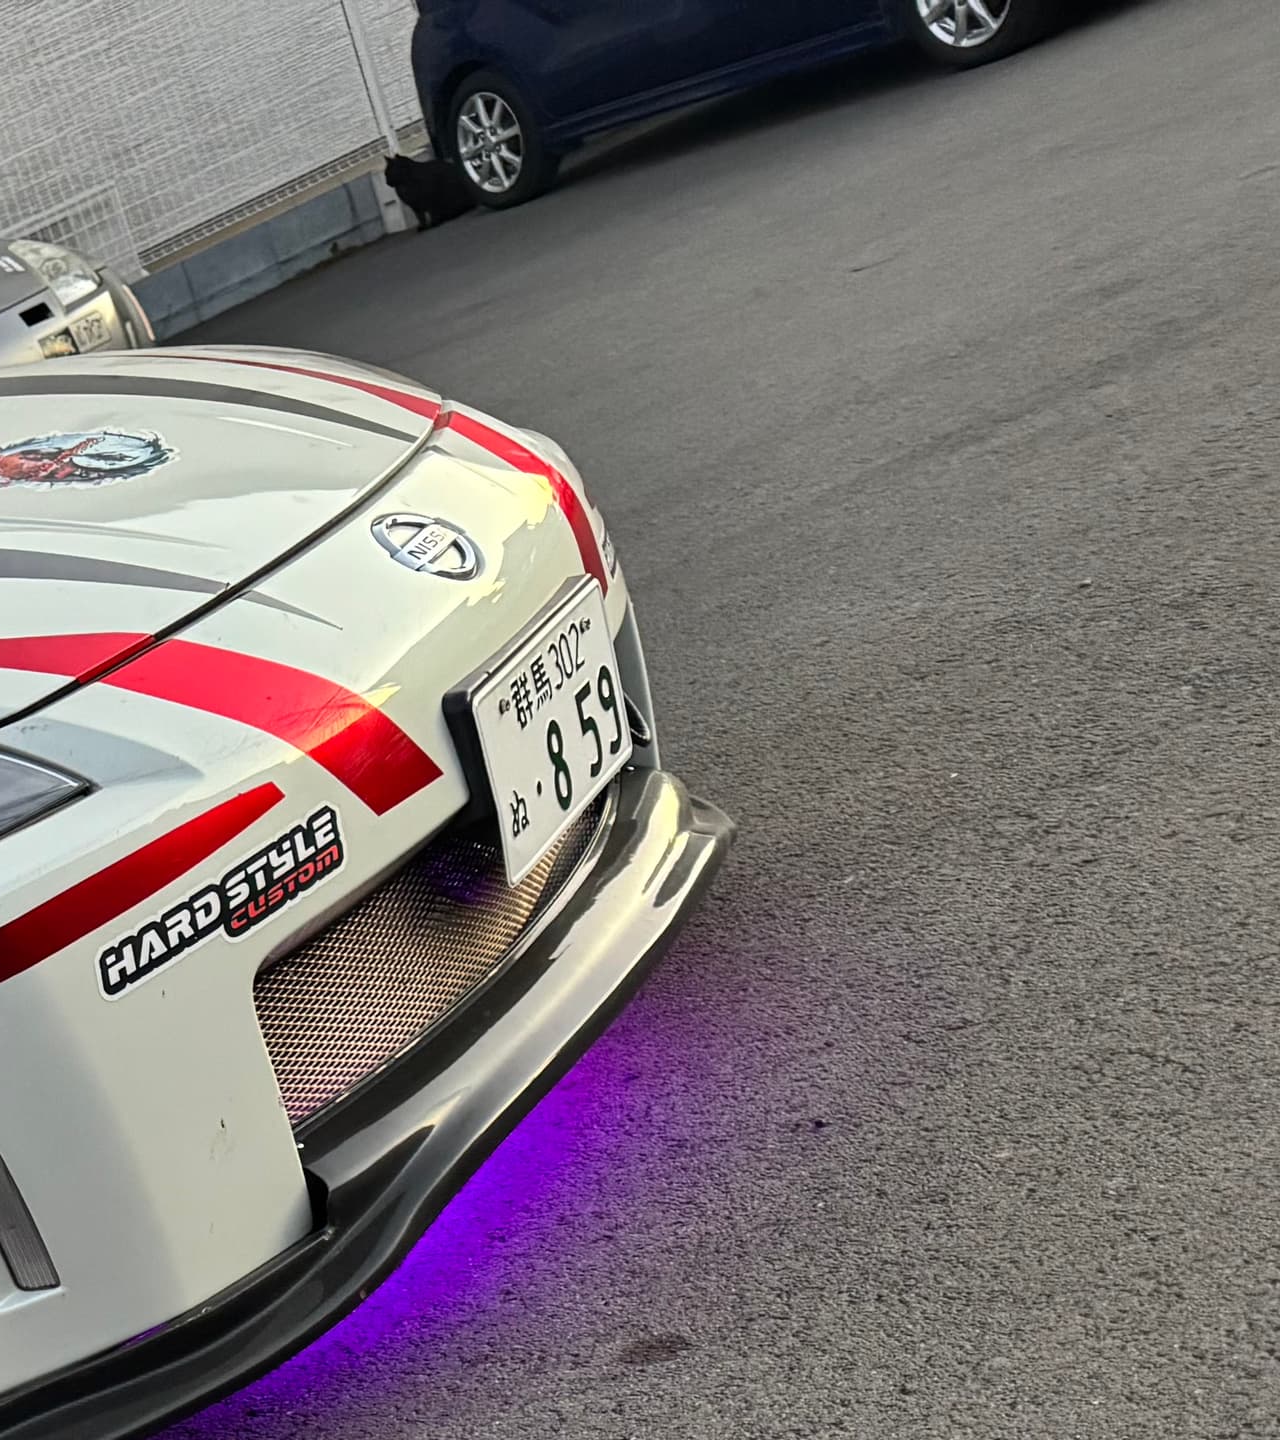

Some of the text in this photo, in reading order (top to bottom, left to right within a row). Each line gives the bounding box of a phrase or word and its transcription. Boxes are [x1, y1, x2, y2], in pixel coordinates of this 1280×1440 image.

[509, 789, 530, 838] ぬ
[105, 811, 336, 986] HARD STYLE
[230, 845, 339, 930] CUSTOM
